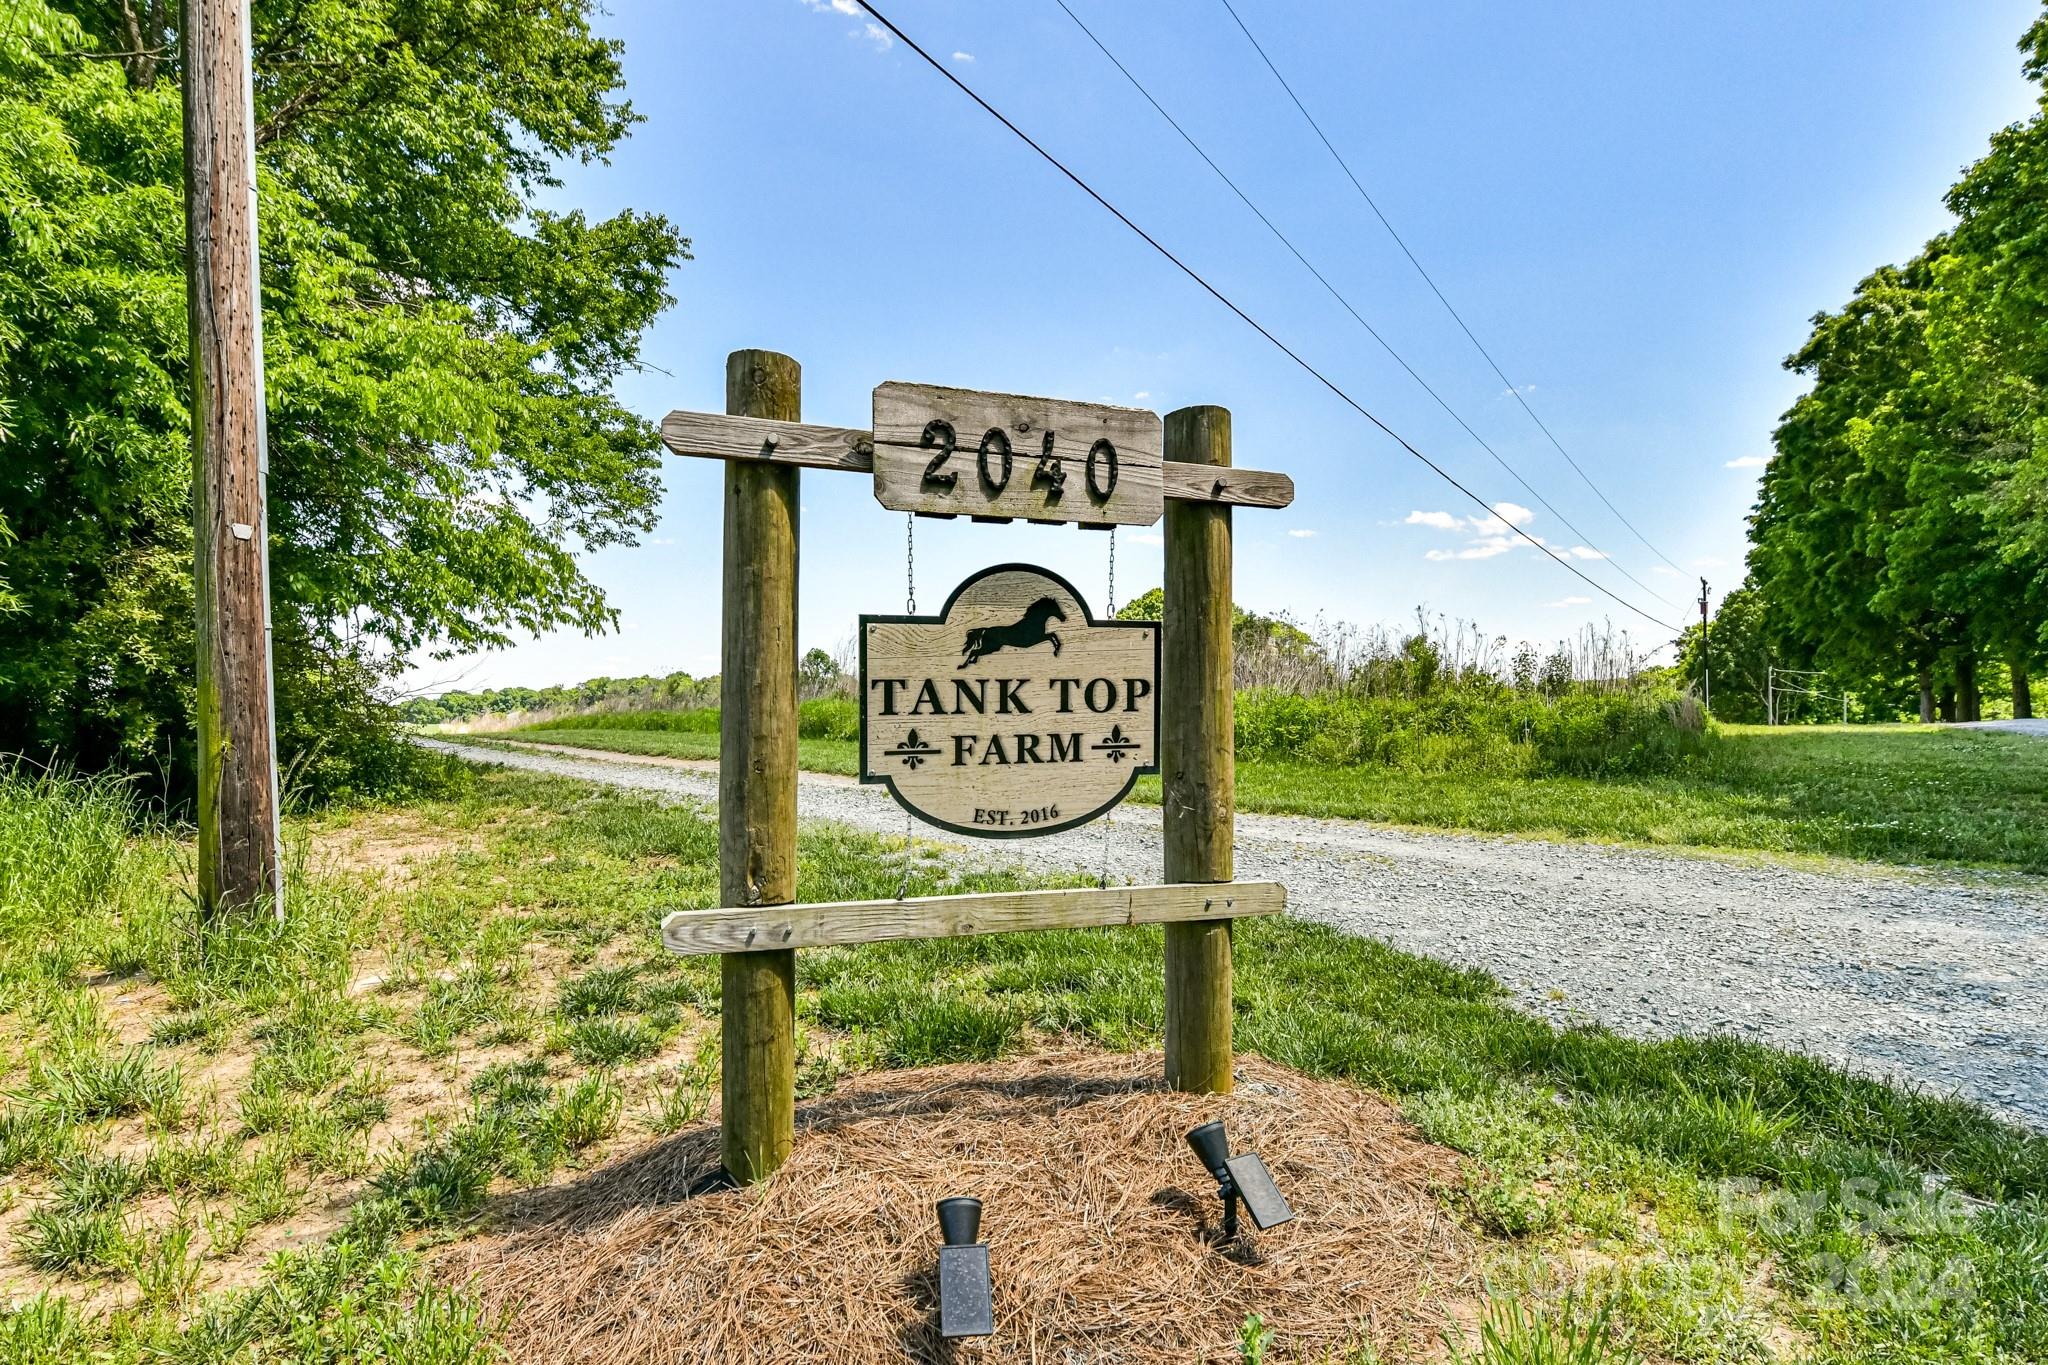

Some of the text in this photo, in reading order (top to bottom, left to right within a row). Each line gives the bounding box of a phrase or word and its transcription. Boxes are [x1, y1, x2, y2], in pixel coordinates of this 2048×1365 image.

[922, 419, 1118, 498] 2040
[871, 678, 1152, 716] TANK TOP
[950, 733, 1084, 767] FARM
[973, 803, 1059, 826] EST. 2016
